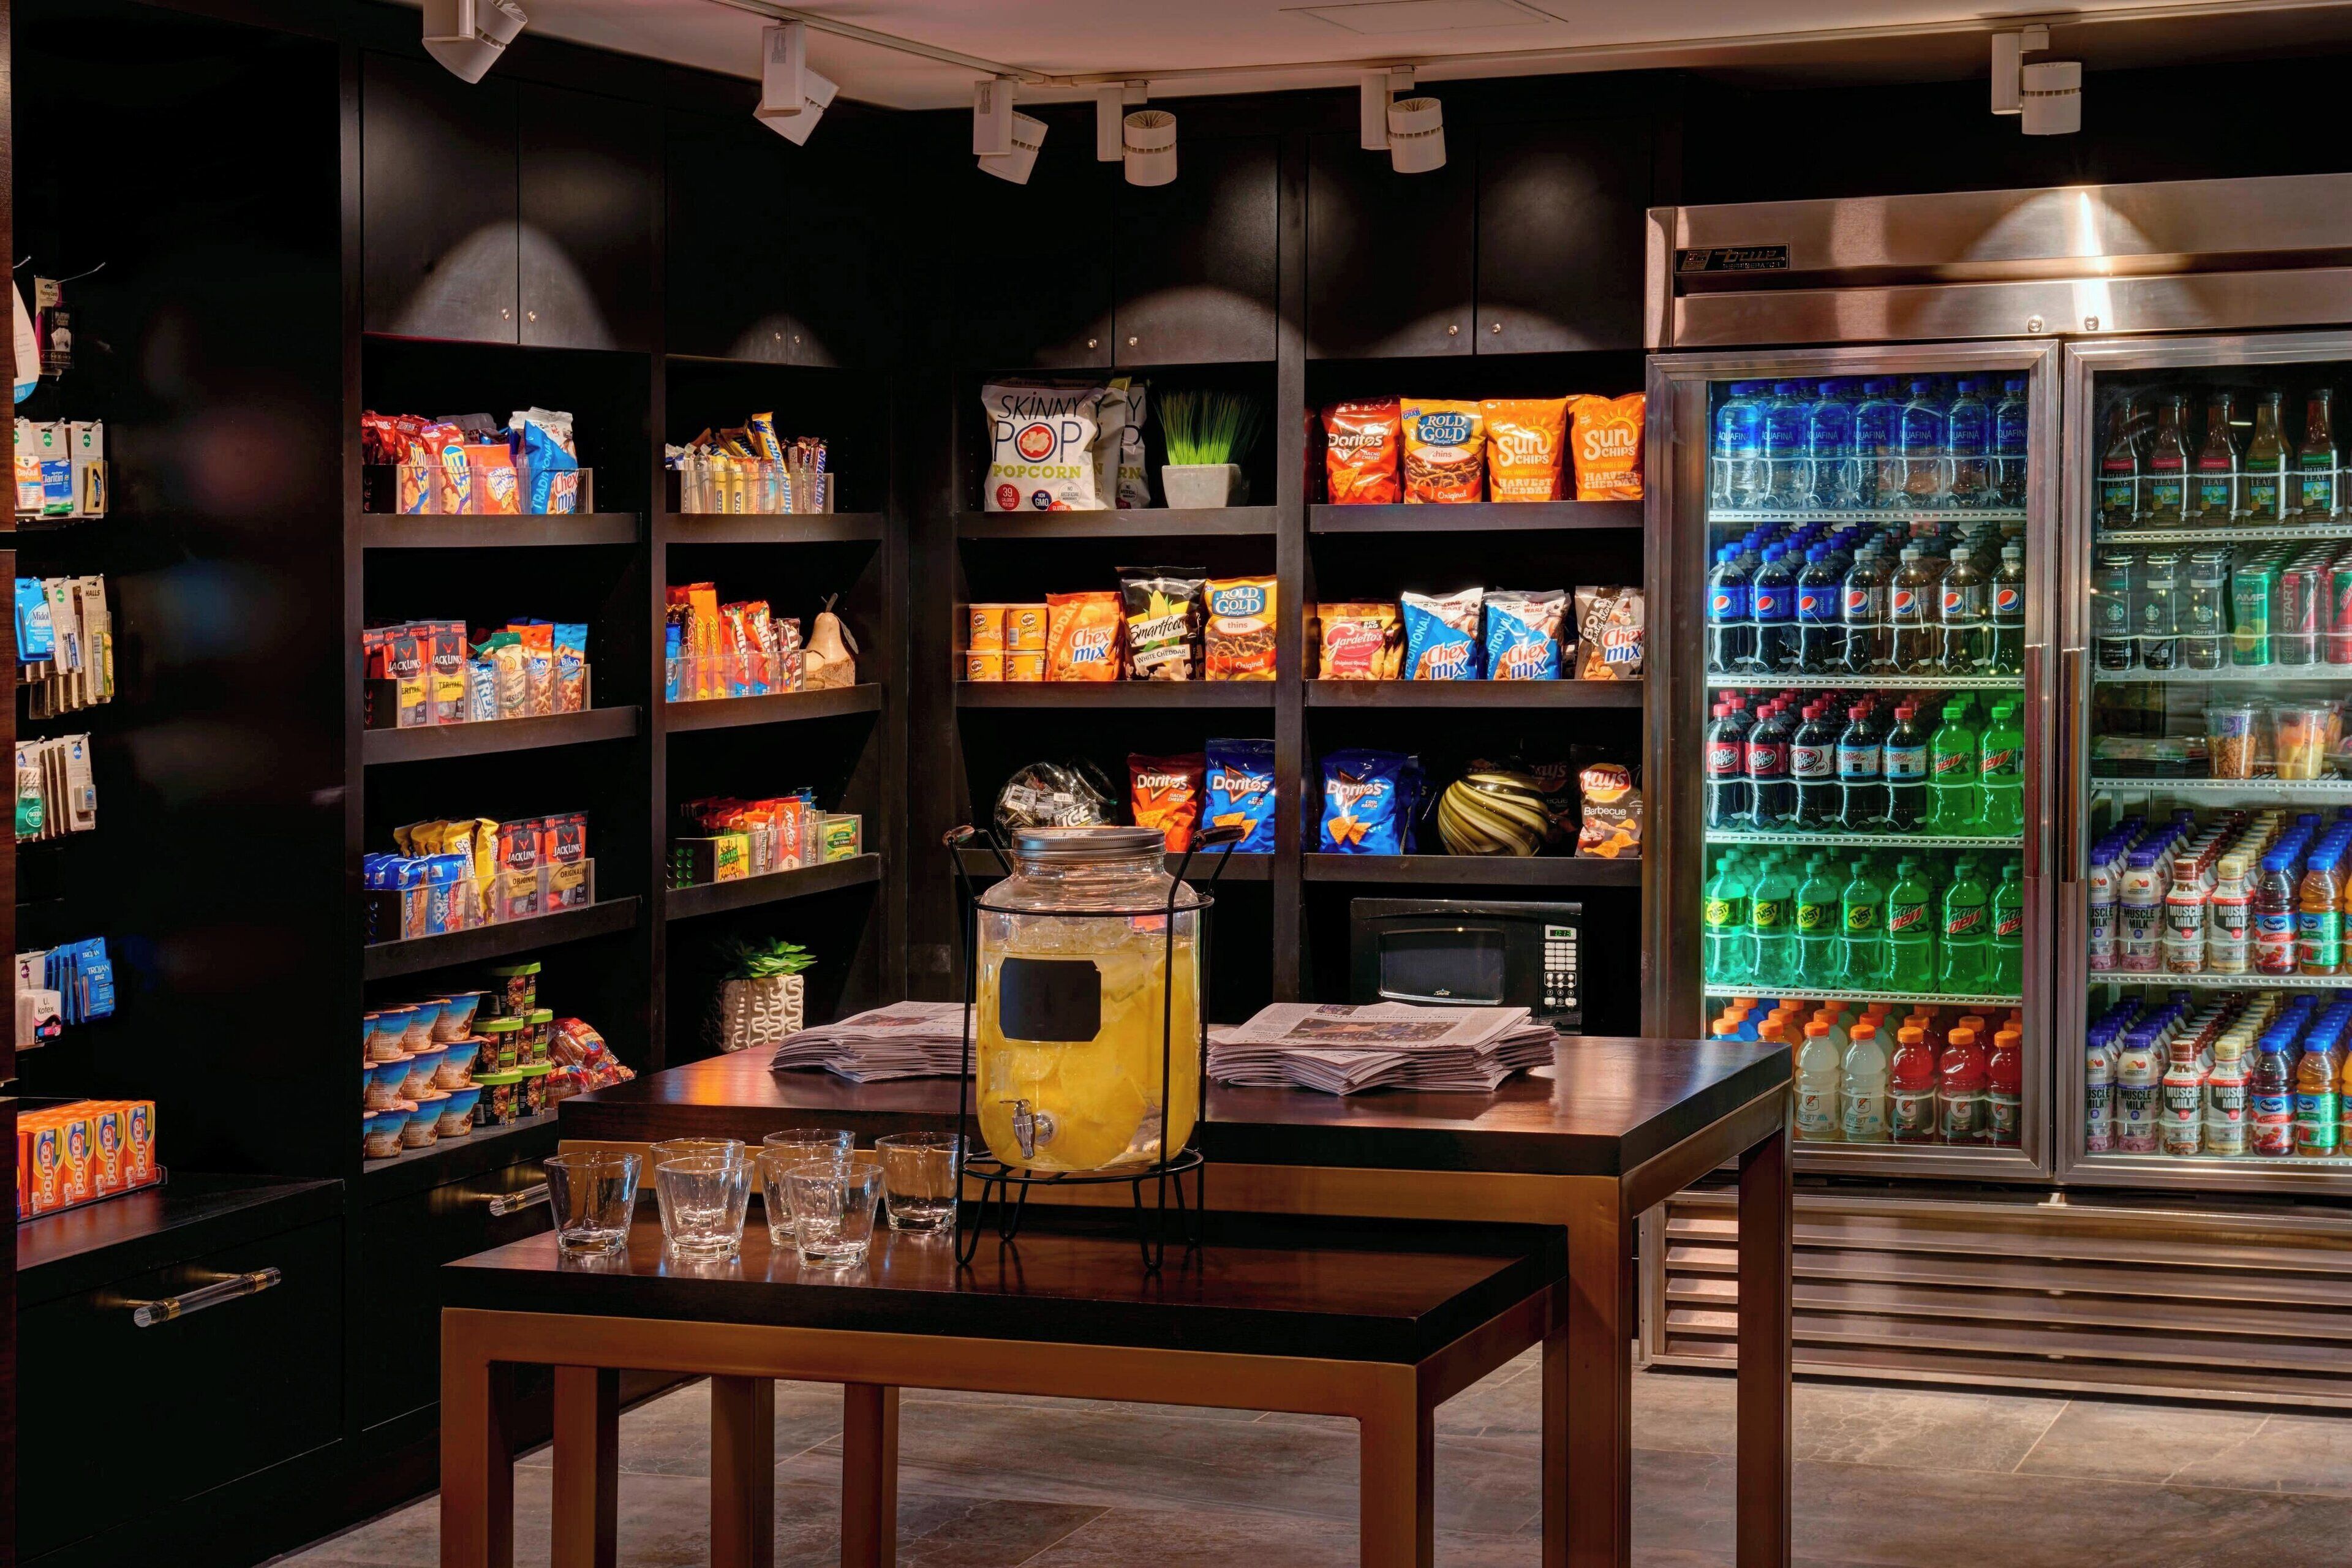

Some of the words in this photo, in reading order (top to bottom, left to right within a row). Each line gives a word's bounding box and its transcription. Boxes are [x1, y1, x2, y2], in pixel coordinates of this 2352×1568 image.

[1427, 415, 1466, 428] ROLD
[1328, 432, 1384, 448] Doritos
[1421, 426, 1466, 442] GOLD
[1762, 431, 1794, 441] AQUAFINA
[1807, 430, 1838, 440] AQUAFINA
[1853, 430, 1887, 440] AQUAFINA
[1899, 430, 1932, 440] AQUAFINA
[1947, 430, 1980, 440] AQUAFINA
[993, 421, 1082, 462] POP
[1583, 428, 1638, 461] Sun
[1498, 435, 1550, 467] Sun
[1600, 446, 1636, 458] CHIPS
[1515, 454, 1550, 465] CHIPS
[993, 464, 1082, 478] POPCORN
[554, 471, 578, 494] Chex
[1003, 488, 1012, 497] 39
[1438, 490, 1467, 499] Original
[557, 491, 577, 512] mix
[1035, 498, 1049, 507] GMO
[1221, 587, 1259, 598] ROLD
[1215, 598, 1261, 613] GOLD
[32, 611, 50, 620] Midol
[1019, 624, 1038, 638] Pringles
[1071, 627, 1113, 648] Chex
[1602, 626, 1644, 647] Chex
[1325, 623, 1384, 662] Gardetto's
[1074, 643, 1108, 663] mix
[1136, 653, 1156, 663] WHITE
[1156, 649, 1186, 658] CHEDDAR
[1426, 641, 1470, 665] Chex
[1506, 639, 1548, 665] Chex
[1605, 643, 1642, 663] mix
[388, 661, 407, 673] JACK
[432, 655, 448, 666] JACK
[1235, 658, 1265, 669] Original
[1430, 657, 1467, 680] mix
[1510, 657, 1547, 679] mix
[1712, 751, 1738, 765] Pepper
[1756, 748, 1767, 757] Dr
[1800, 750, 1811, 759] Dr
[1751, 752, 1774, 767] Pepper
[1137, 774, 1188, 789] Doritos
[1212, 775, 1270, 792] Doritos
[1327, 779, 1382, 796] Doritos
[1583, 771, 1627, 791] Lay's
[1062, 807, 1092, 827] ICE
[1584, 806, 1627, 816] Barbecue
[546, 819, 555, 827] 110
[507, 851, 523, 863] JACK
[552, 846, 568, 857] JACK
[719, 848, 739, 865] SOUR
[718, 861, 740, 880] PATCH
[2124, 908, 2155, 919] MUSCLE
[2169, 905, 2204, 916] MUSCLE
[2128, 919, 2149, 929] MILK
[2175, 916, 2198, 927] MILK
[2225, 916, 2248, 927] MILK
[87, 964, 109, 975] TROJAN
[2120, 1090, 2152, 1100] MUSCLE
[2166, 1087, 2201, 1098] MUSCLE
[2125, 1100, 2146, 1110] MILK
[2172, 1098, 2196, 1109] MILK
[2223, 1098, 2245, 1109] MILK
[2261, 1115, 2285, 1123] Cranberry
[134, 1117, 147, 1178] bounce
[103, 1125, 118, 1185] bounce
[72, 1133, 85, 1196] bounce
[40, 1141, 53, 1205] bounce
